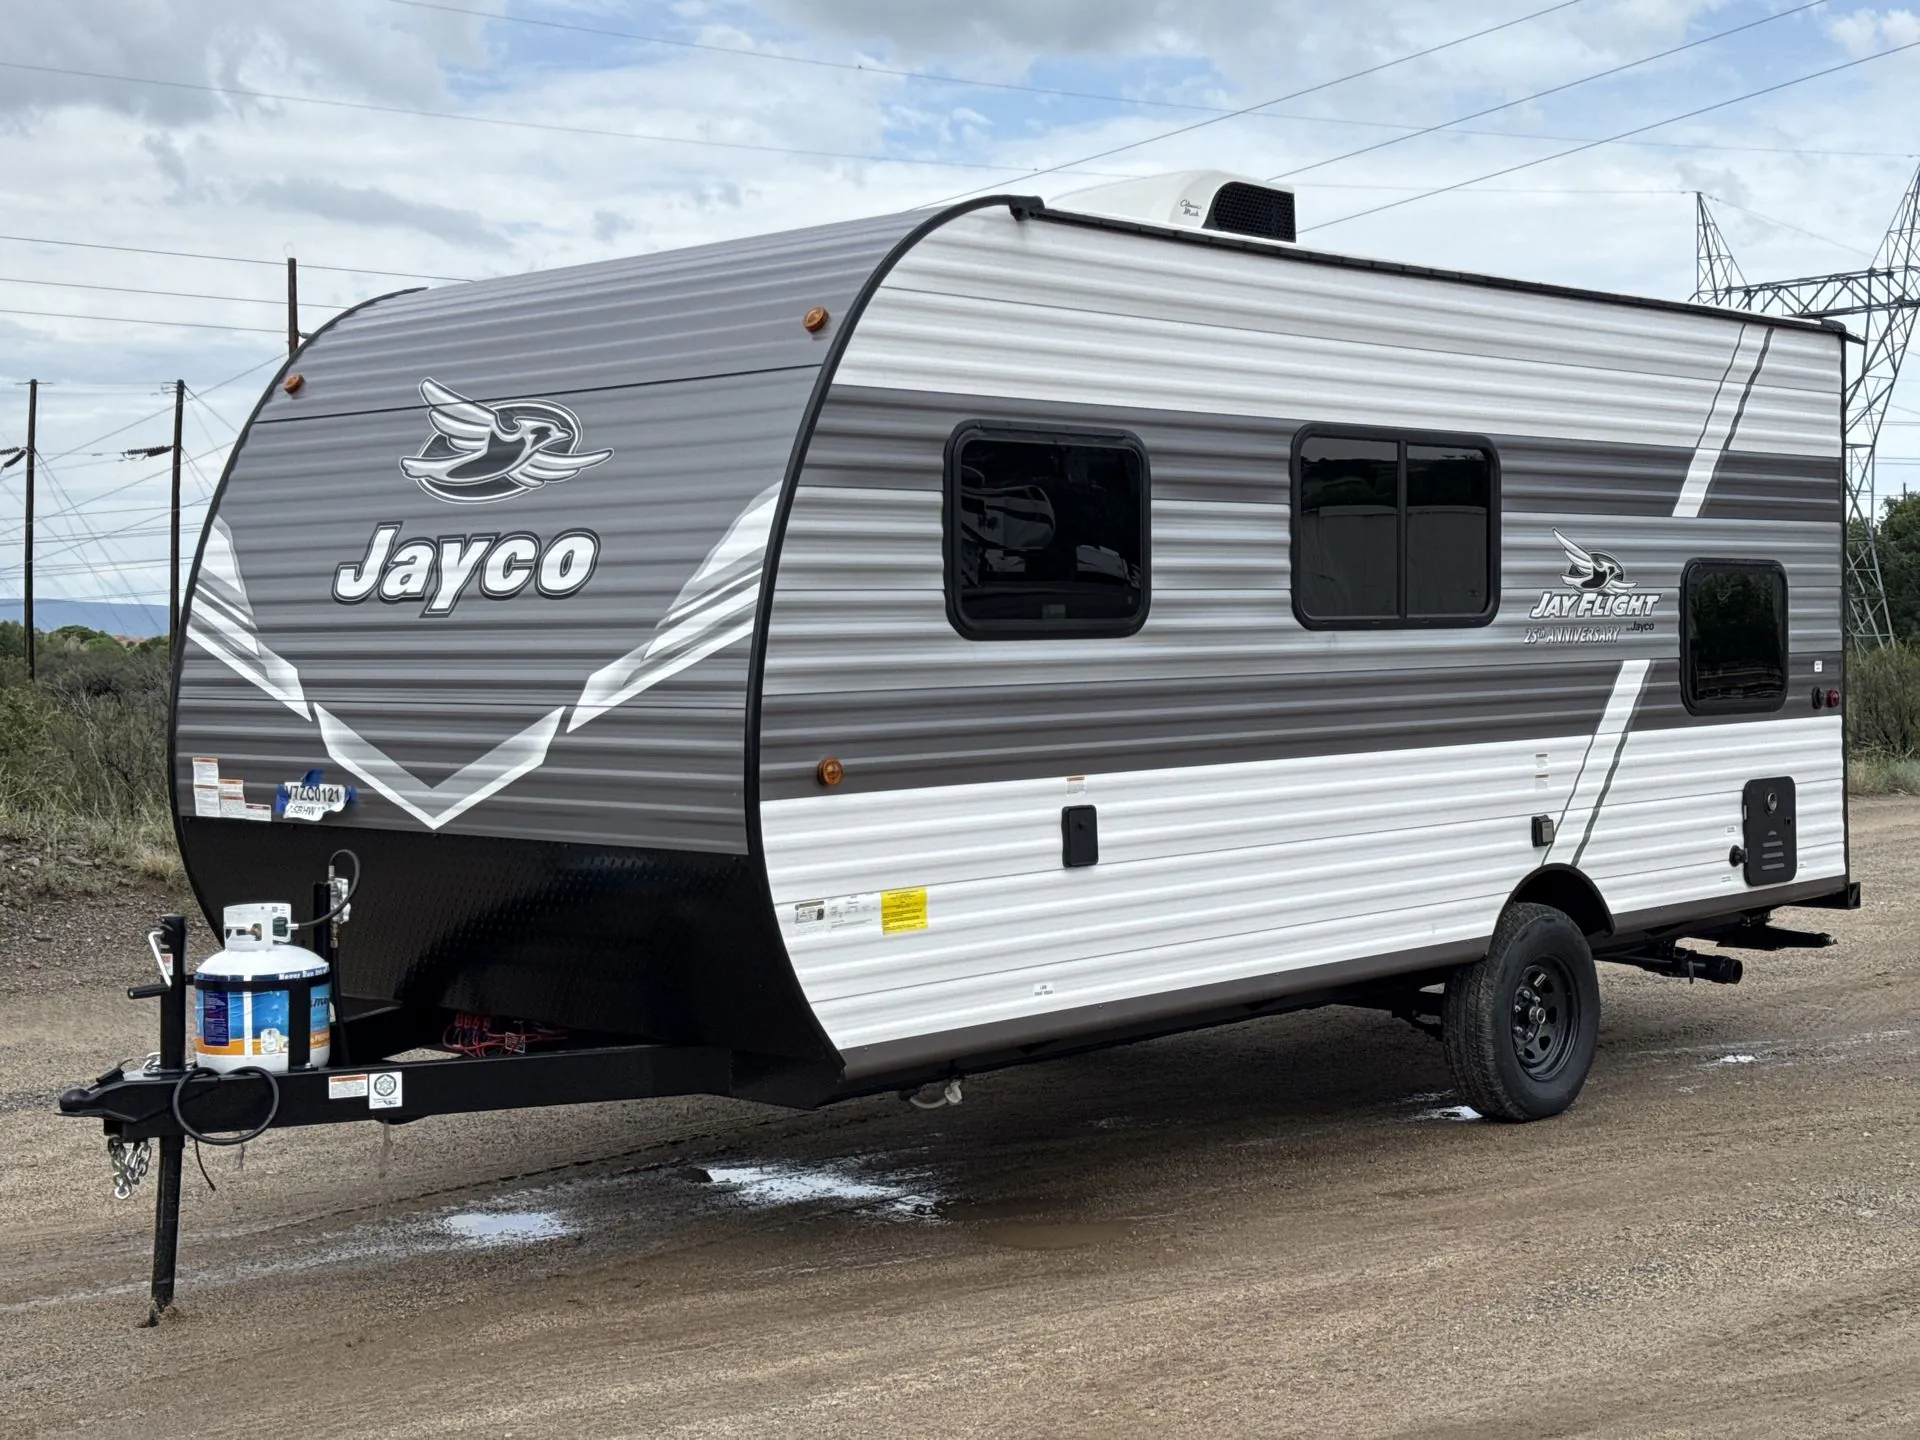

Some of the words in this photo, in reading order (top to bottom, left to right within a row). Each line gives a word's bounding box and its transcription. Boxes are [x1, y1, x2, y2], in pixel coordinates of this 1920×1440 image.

[332, 521, 601, 618] Jayco
[1529, 591, 1579, 619] JAY
[1576, 592, 1662, 618] FLIGHT
[1546, 626, 1620, 645] ANNIVERSARY
[1630, 620, 1655, 633] Jayco
